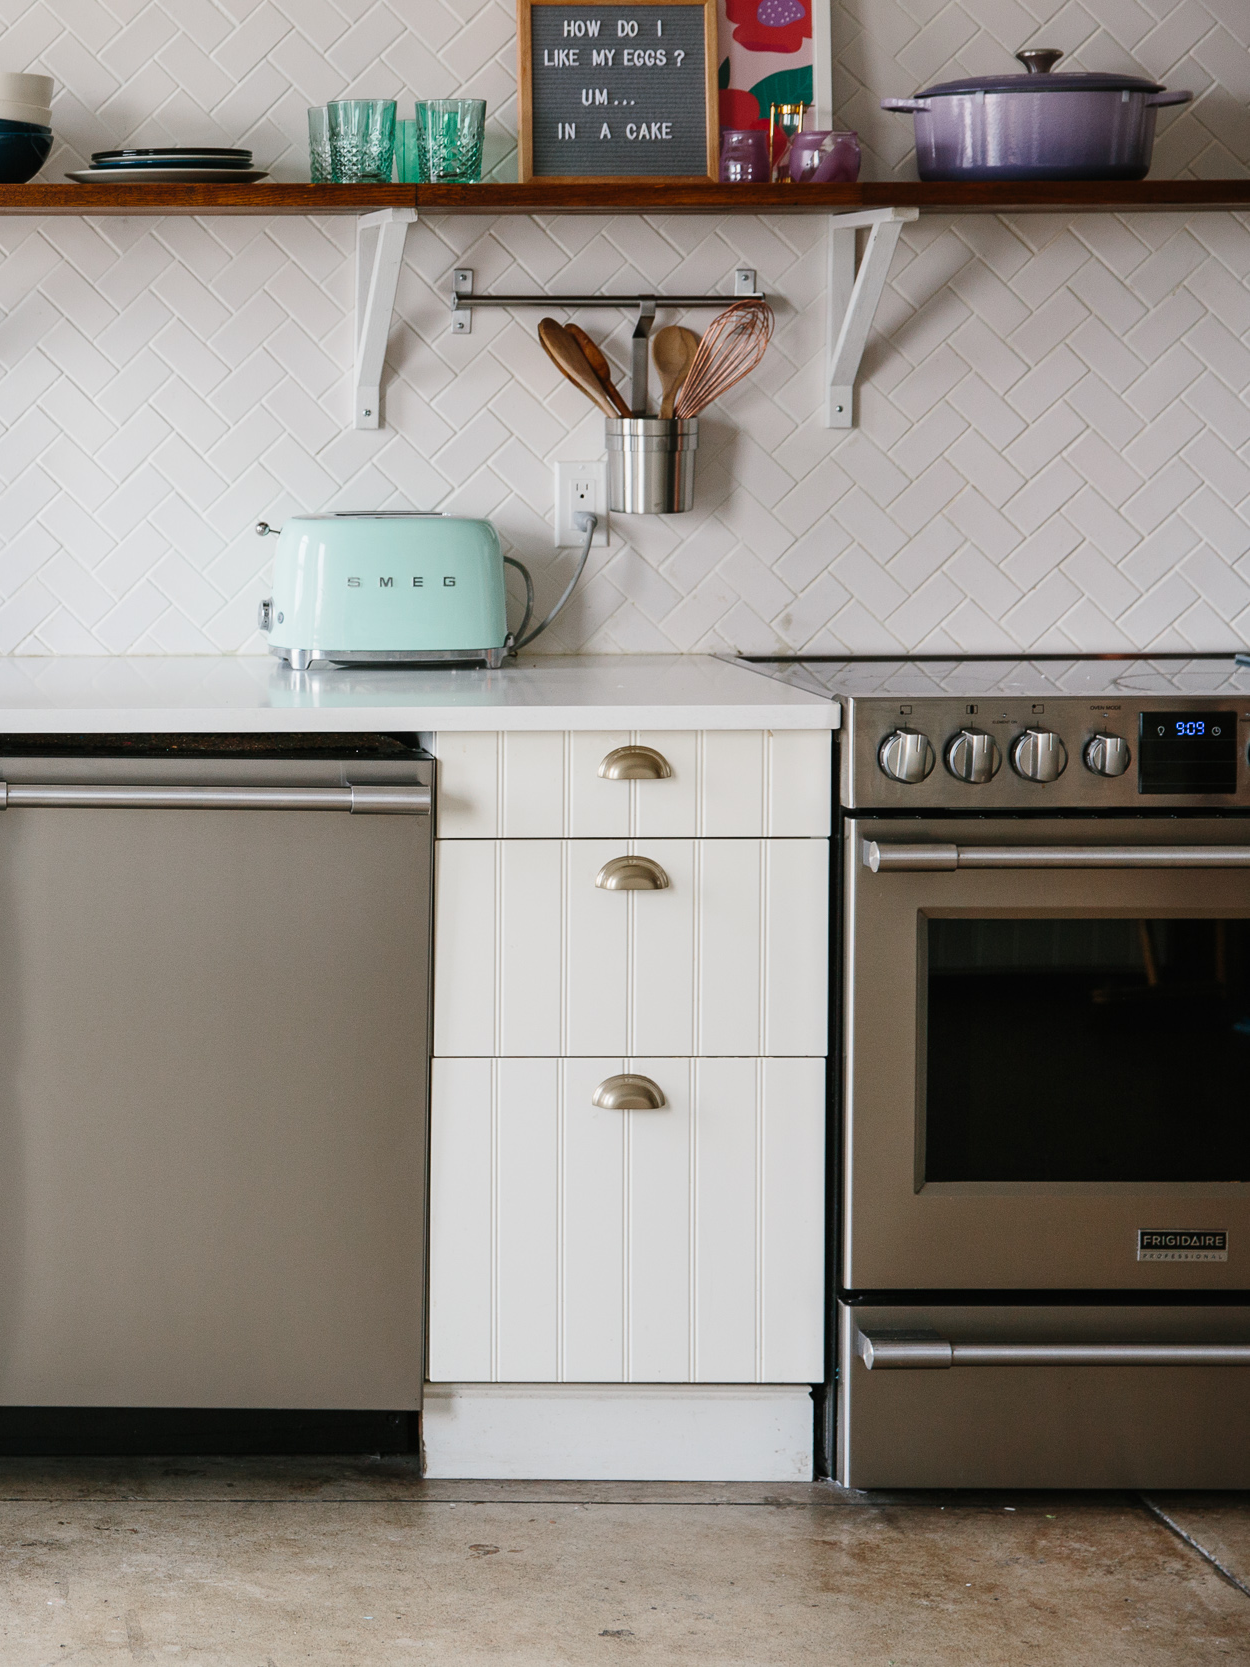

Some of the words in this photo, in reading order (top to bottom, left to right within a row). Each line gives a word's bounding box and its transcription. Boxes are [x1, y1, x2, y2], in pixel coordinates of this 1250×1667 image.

[563, 20, 601, 37] HOW
[617, 20, 638, 37] DO
[657, 19, 662, 37] I
[543, 49, 580, 67] LIKE
[592, 49, 616, 67] MY
[581, 88, 636, 106] UM...
[558, 122, 576, 140] IN
[600, 122, 611, 140] A
[626, 122, 673, 140] CAKE
[347, 576, 456, 588] SMEG
[1175, 721, 1205, 736] 9:09
[1143, 1235, 1224, 1246] FRIGIDAIRE
